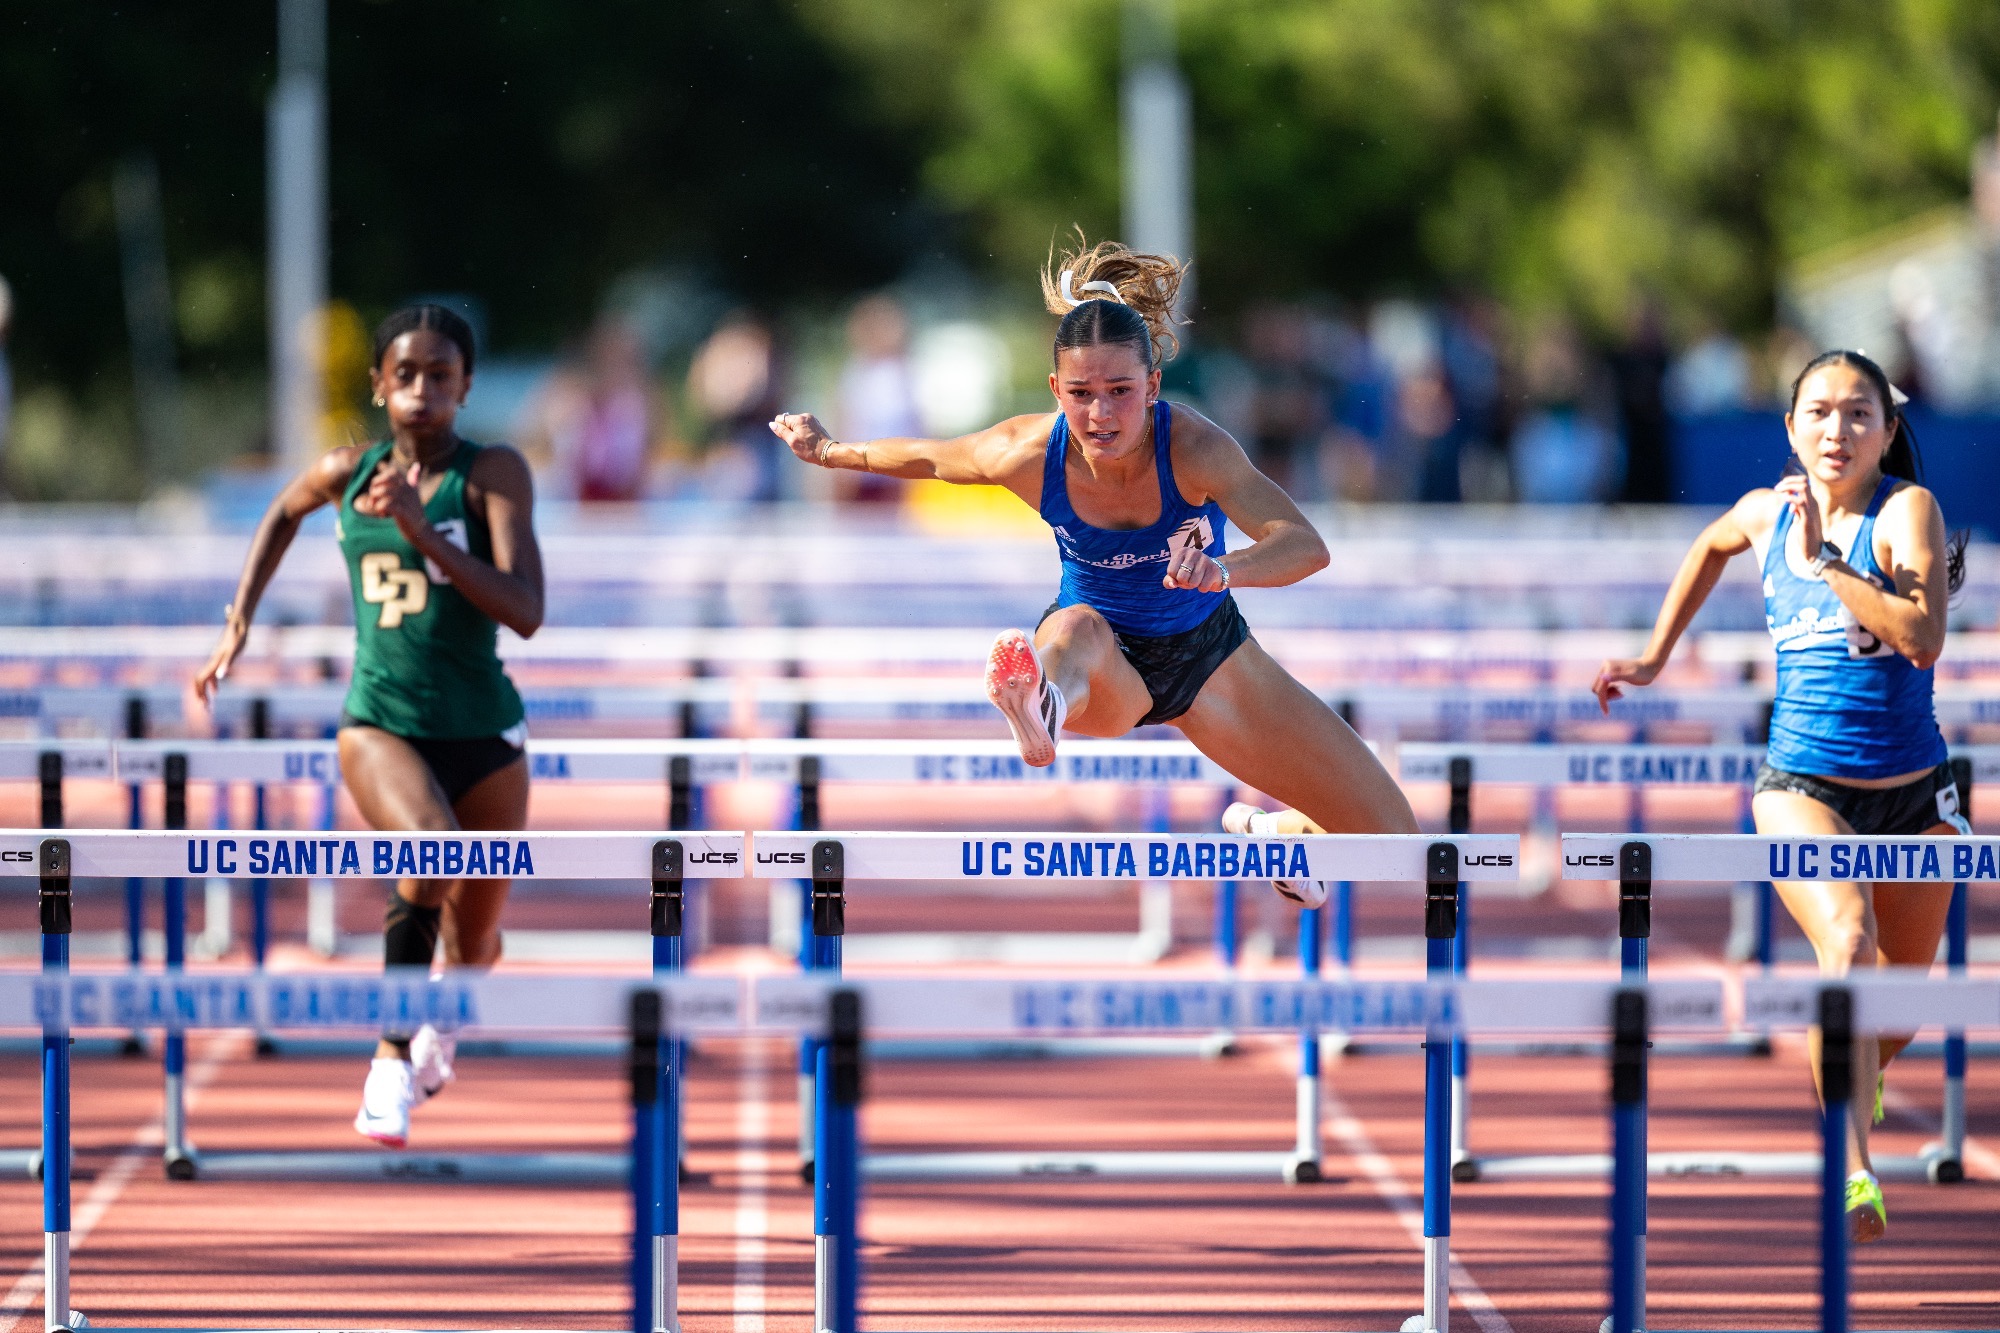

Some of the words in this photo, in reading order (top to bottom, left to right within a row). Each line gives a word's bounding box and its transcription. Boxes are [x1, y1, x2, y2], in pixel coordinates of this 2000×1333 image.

[361, 552, 429, 629] CP
[970, 754, 1061, 782] SANA
[1619, 756, 1713, 783] SANTA
[0, 851, 33, 862] CS
[188, 839, 237, 874] UC
[249, 840, 361, 875] SANTA
[373, 840, 535, 875] BARBARA
[690, 852, 738, 864] UCS
[757, 852, 805, 864] UCS
[963, 842, 1012, 876] UC
[1023, 842, 1137, 877] SANTA
[1149, 843, 1310, 877] BARBARA
[1465, 855, 1513, 867] UCS
[1566, 855, 1614, 867] UCS
[1769, 843, 1818, 878] UC
[1830, 844, 1941, 878] SANTA
[1953, 844, 2000, 879] BA
